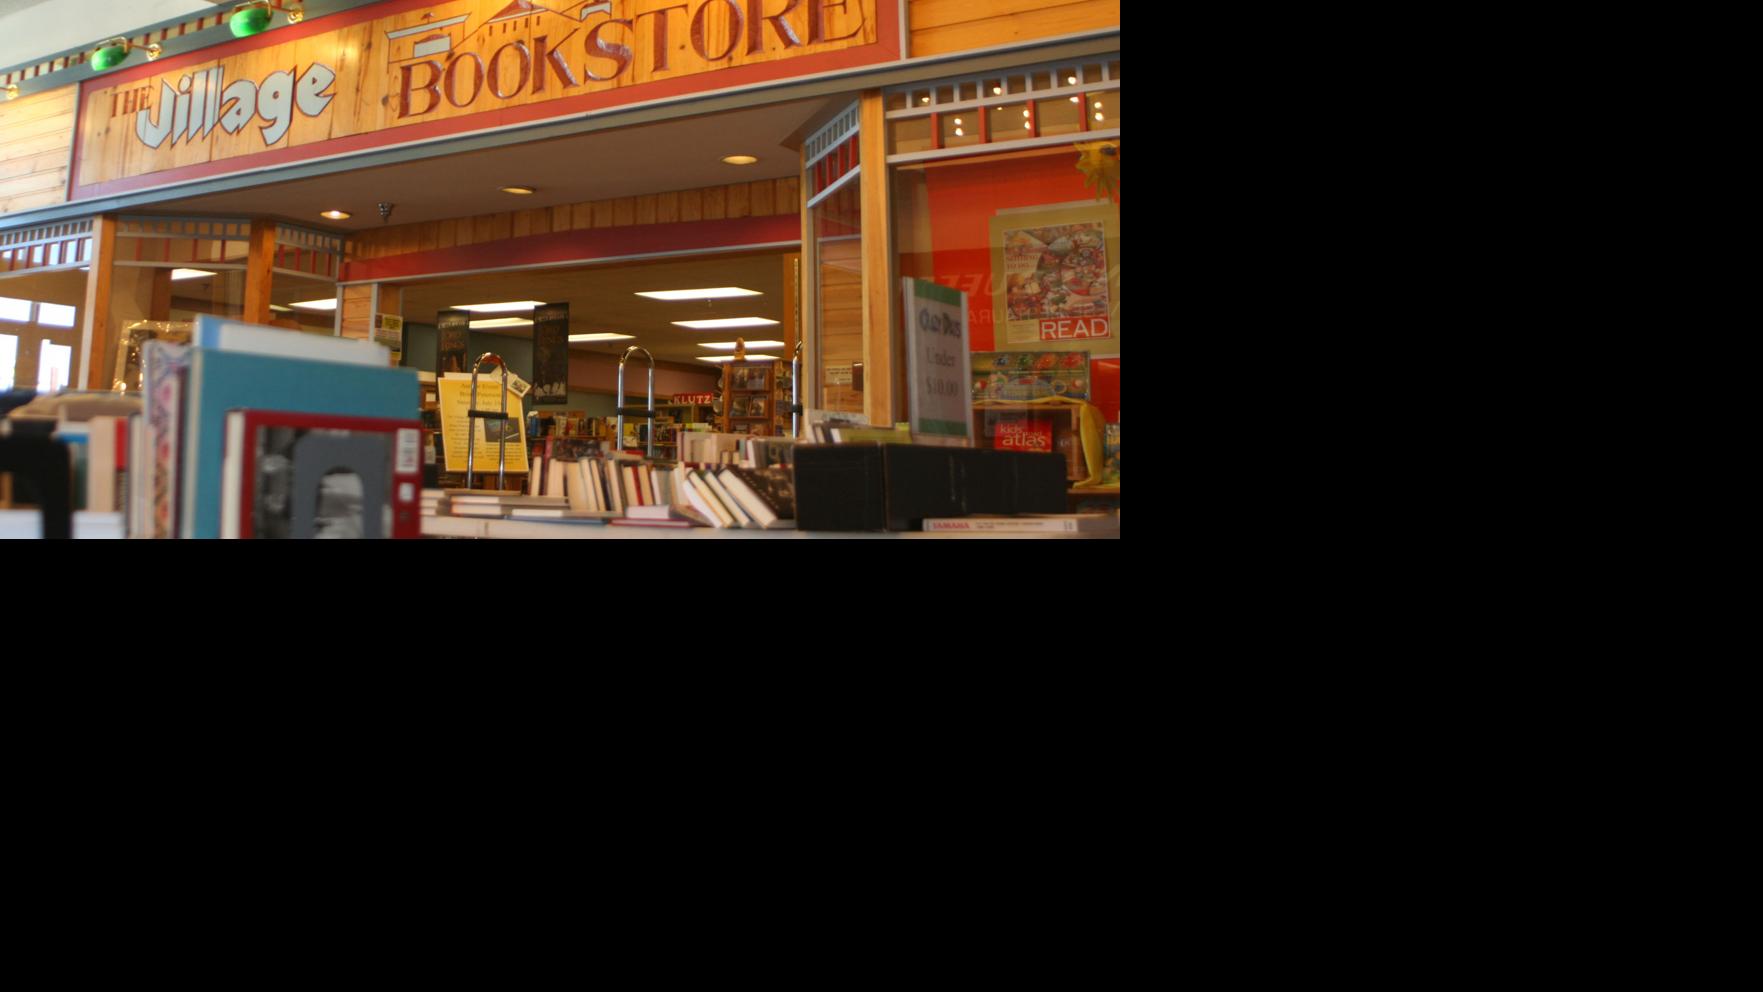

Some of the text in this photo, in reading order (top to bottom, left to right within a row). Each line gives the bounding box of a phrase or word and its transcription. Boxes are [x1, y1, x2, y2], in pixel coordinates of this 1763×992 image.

[397, 0, 865, 120] BOOKSTORE
[111, 62, 336, 150] THE Village
[1040, 318, 1109, 340] READ
[673, 395, 712, 405] KLUTZ
[1002, 432, 1047, 447] atlas
